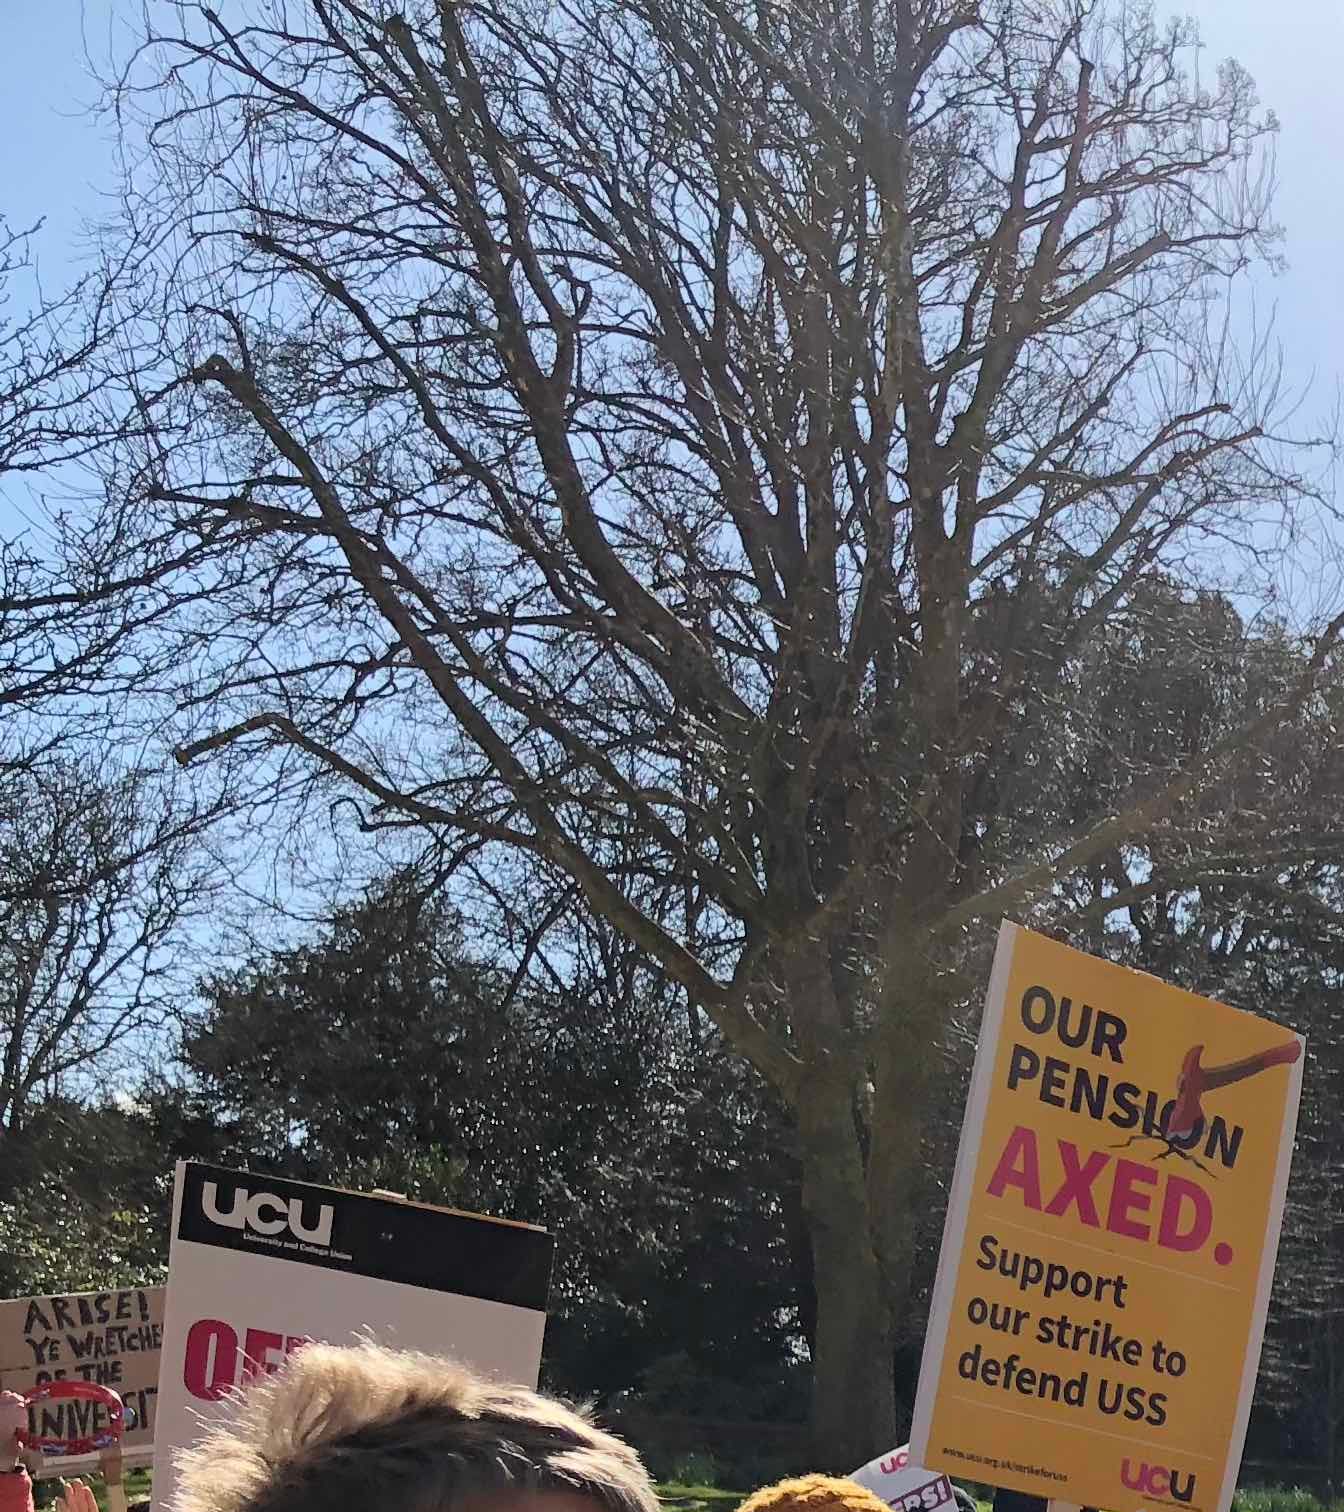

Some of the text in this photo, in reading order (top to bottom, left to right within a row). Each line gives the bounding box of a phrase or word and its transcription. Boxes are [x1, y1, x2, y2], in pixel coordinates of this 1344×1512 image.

[1020, 985, 1128, 1064] OUR
[1006, 1044, 1245, 1169] PENSION
[986, 1126, 1233, 1266] AXED.
[976, 1234, 1128, 1309] Support
[24, 1291, 150, 1334] ARISE!
[66, 1323, 164, 1360] WRETCHE
[967, 1296, 1188, 1378] our strike to
[75, 1360, 122, 1384] THE
[958, 1345, 1168, 1428] defend USS
